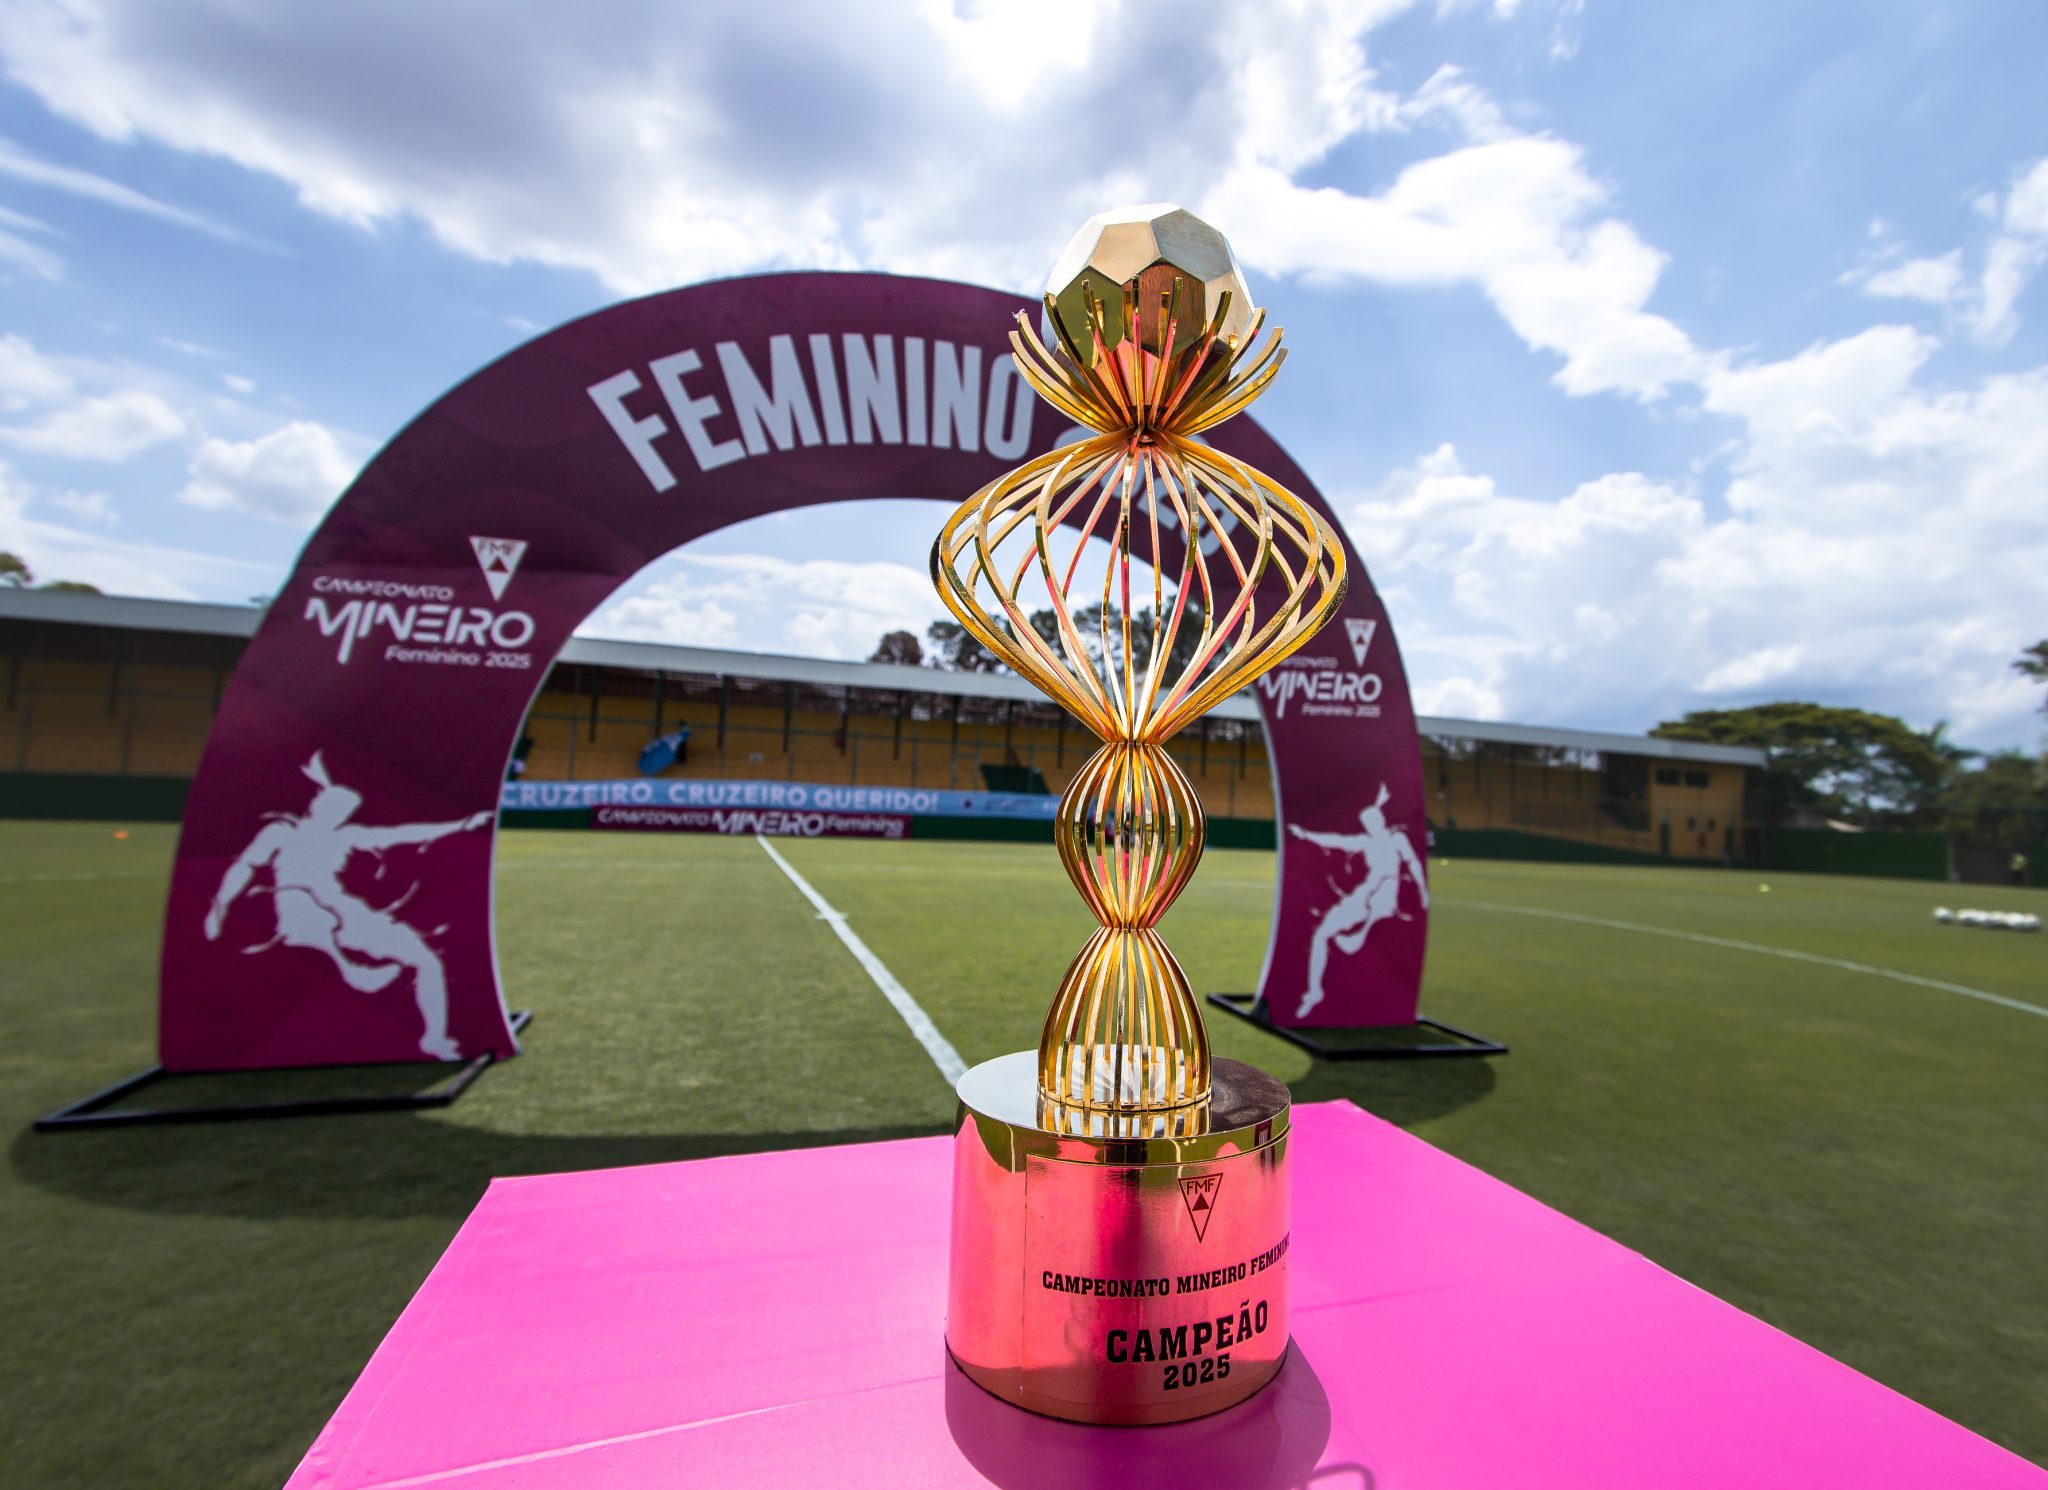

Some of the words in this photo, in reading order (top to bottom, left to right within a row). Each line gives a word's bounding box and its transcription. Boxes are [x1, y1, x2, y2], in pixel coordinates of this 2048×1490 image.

[586, 333, 1036, 493] FEMININO
[312, 576, 455, 601] CAMPEONATO
[304, 597, 535, 665] MINEIRO
[385, 644, 480, 666] Feminino
[483, 650, 531, 669] 2025
[1258, 670, 1383, 720] MINEIRO
[667, 781, 808, 807] CRUZEIRO
[813, 786, 938, 812] QUERIDO!
[597, 807, 712, 827] CAMPEONATO
[711, 809, 825, 837] MINEIRO
[1186, 1178, 1215, 1196] FMF
[1042, 1270, 1170, 1298] CAMPEONATO
[1176, 1262, 1246, 1295] MINEIRO
[1106, 1299, 1268, 1364] CAMPEÃO
[1163, 1353, 1230, 1391] 2025
